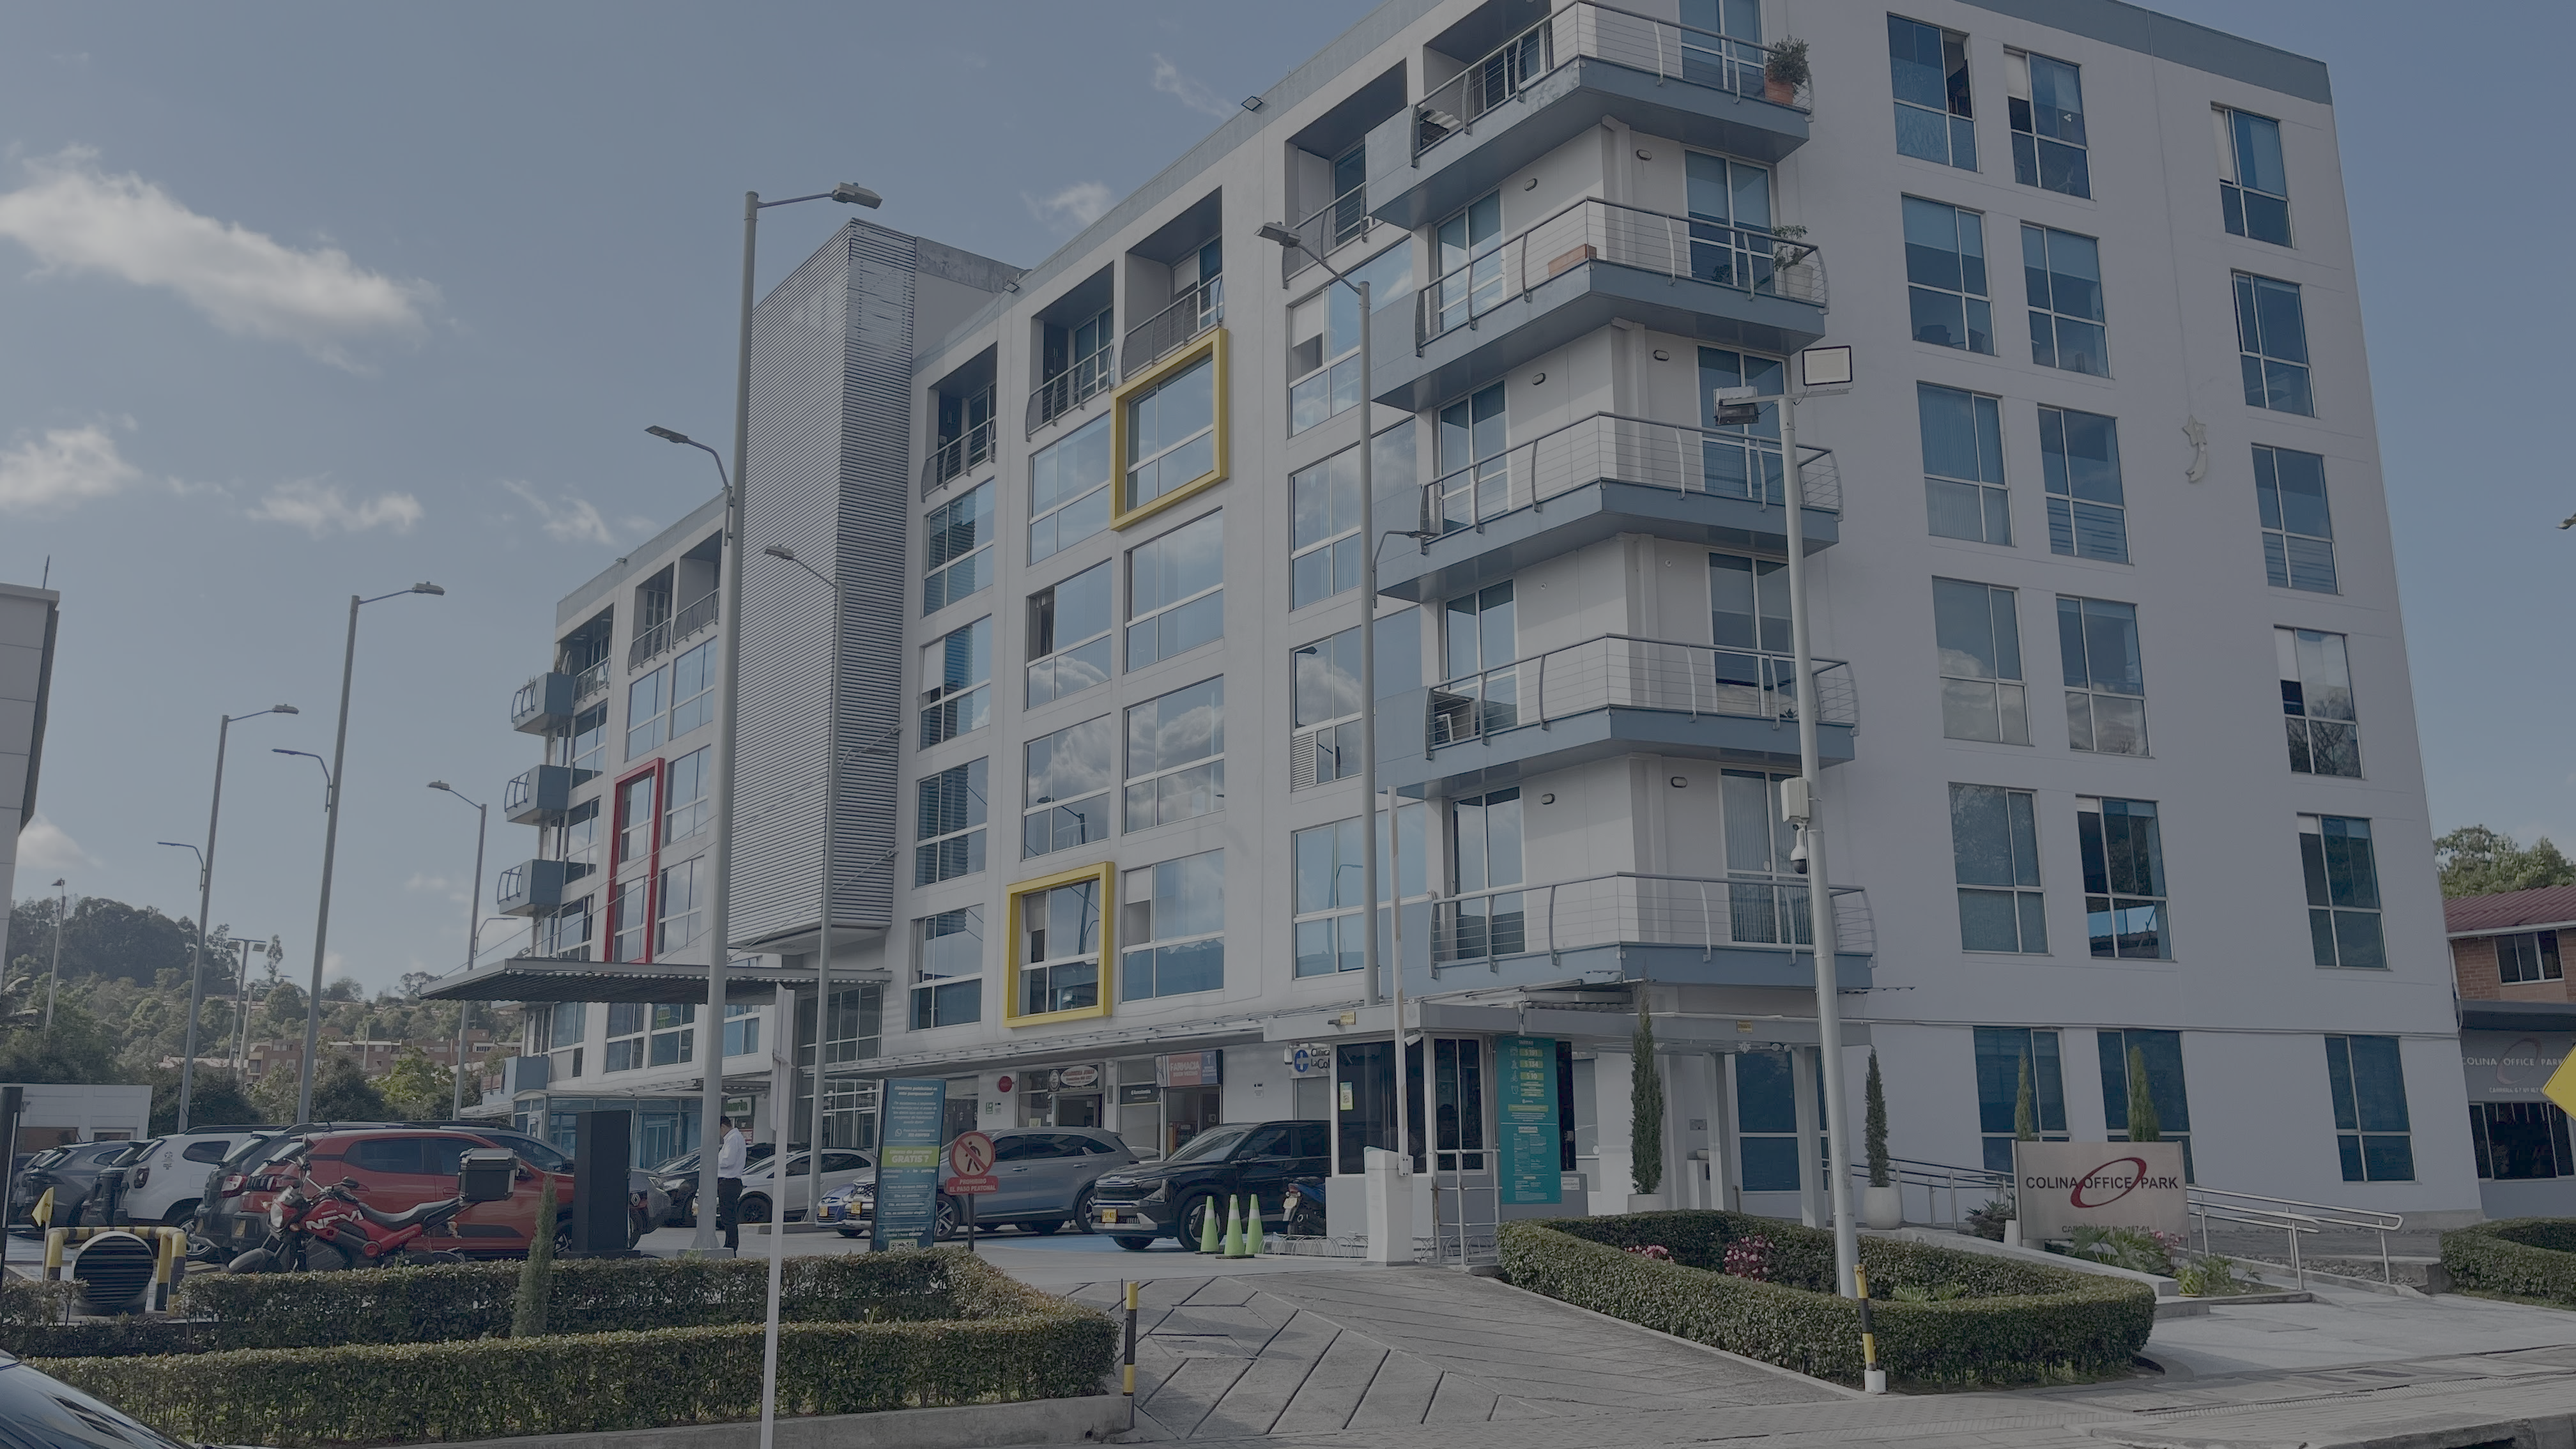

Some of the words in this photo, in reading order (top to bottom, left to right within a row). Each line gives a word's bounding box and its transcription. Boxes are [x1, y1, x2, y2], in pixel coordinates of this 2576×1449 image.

[1170, 1061, 1200, 1071] FARMACIA
[1317, 1057, 1330, 1069] Col
[2462, 1057, 2497, 1066] COLINA
[2503, 1057, 2534, 1066] OFFICE
[2541, 1058, 2563, 1066] PARK
[2026, 1177, 2077, 1188] COLINA
[2083, 1177, 2132, 1188] OFFICE
[2141, 1177, 2178, 1188] PARK
